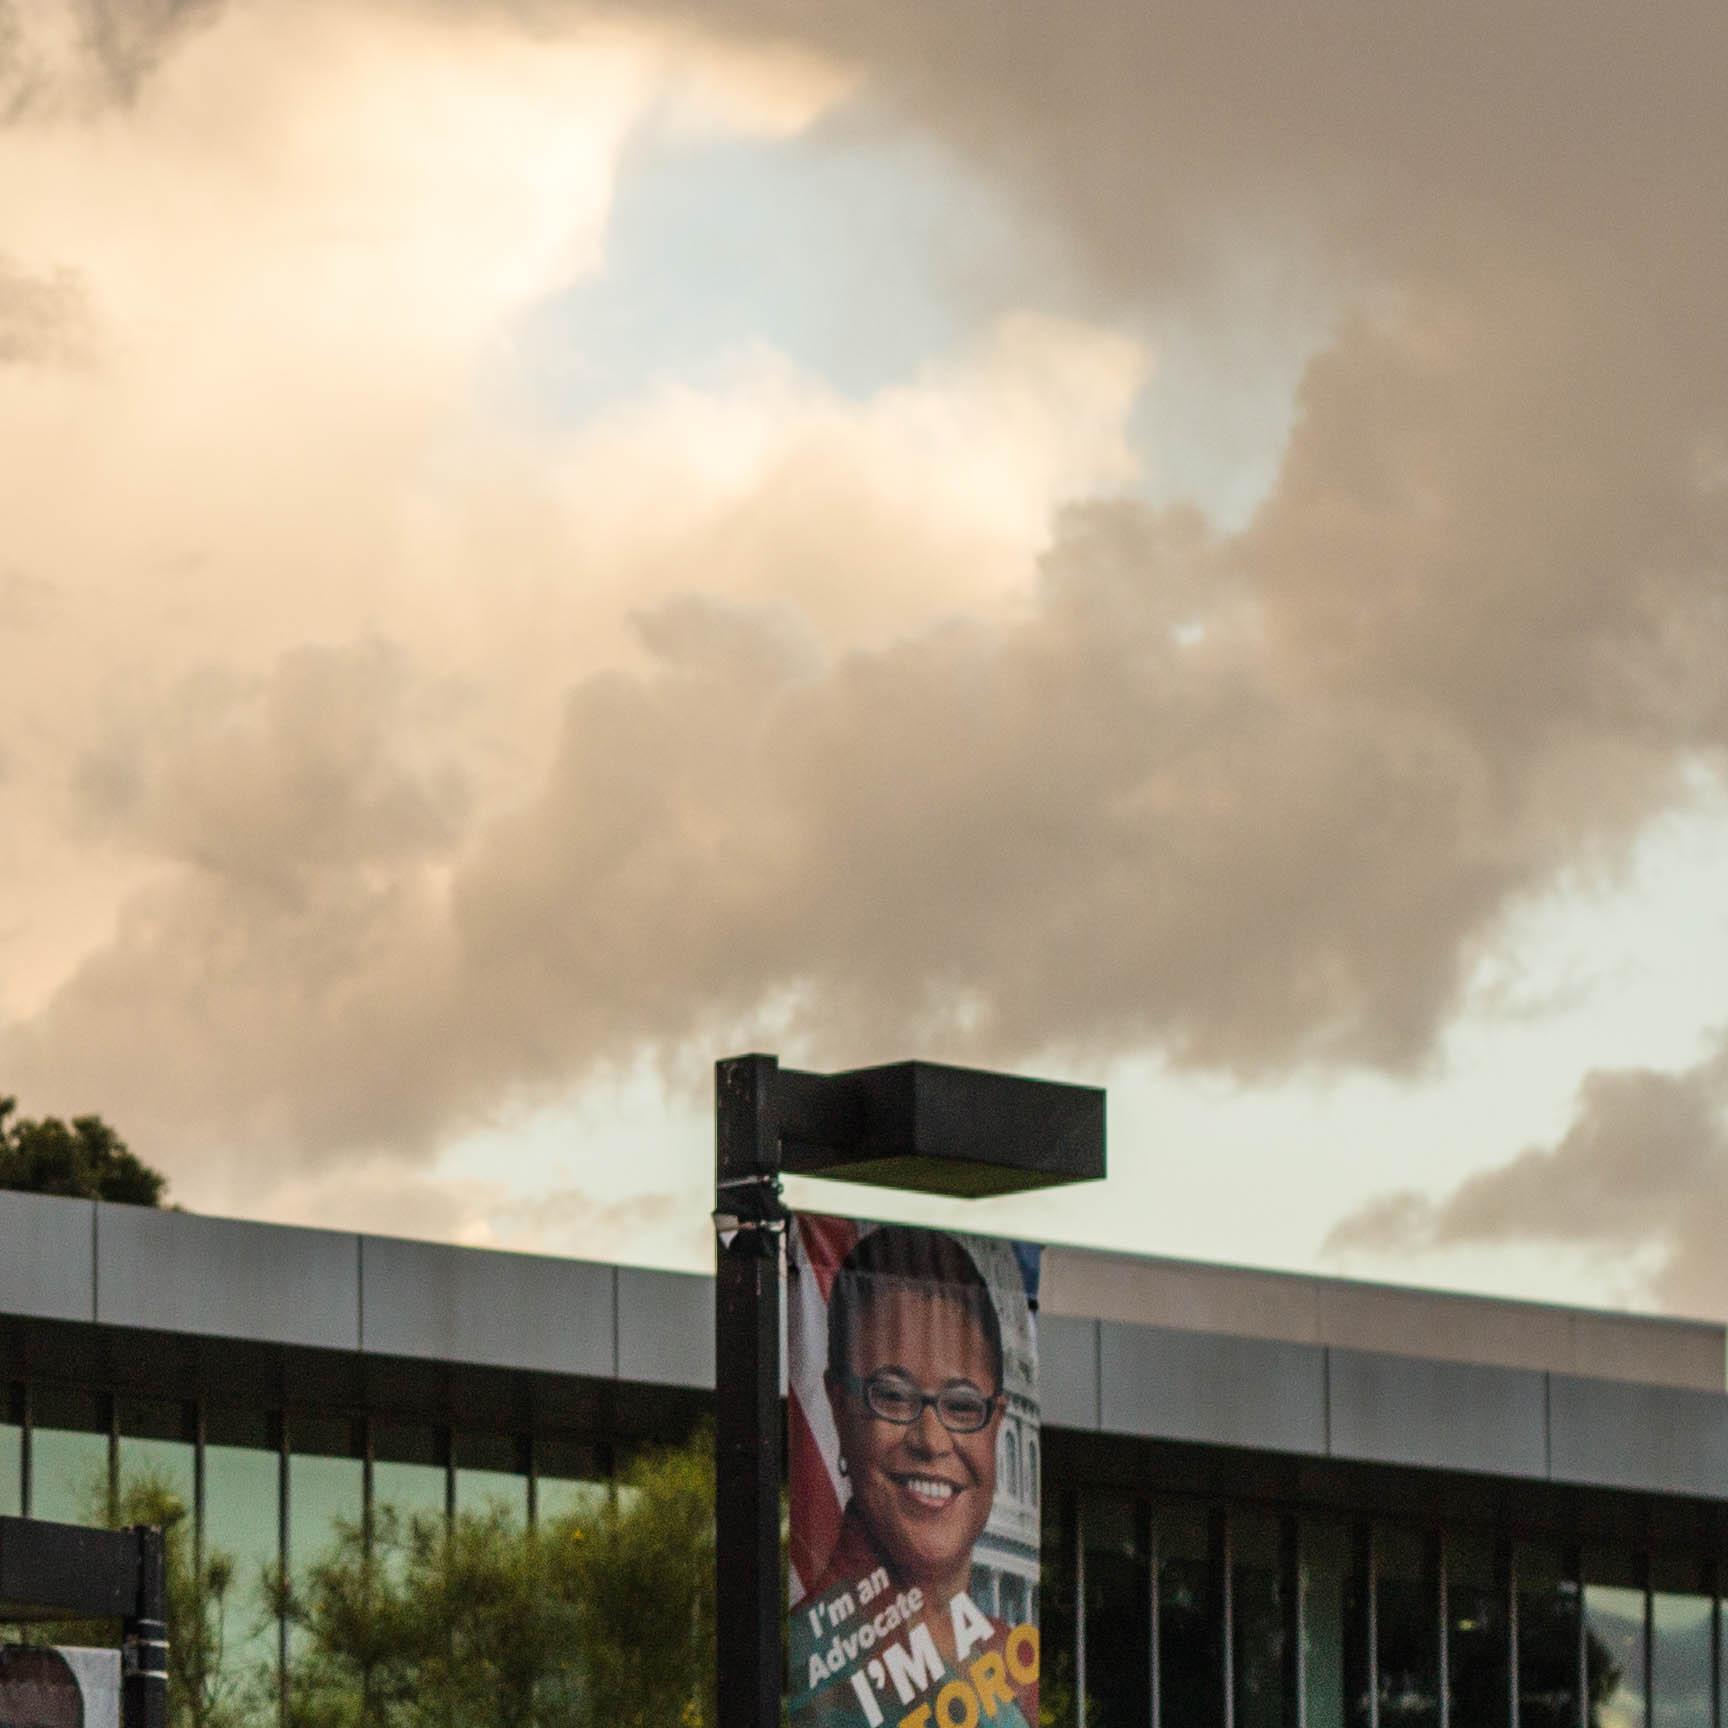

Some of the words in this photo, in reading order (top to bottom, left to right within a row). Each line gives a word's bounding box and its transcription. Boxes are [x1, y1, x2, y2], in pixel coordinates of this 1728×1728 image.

[808, 1592, 855, 1639] I'm
[856, 1566, 890, 1605] an
[808, 1586, 924, 1689] Advocate
[949, 1591, 996, 1662] A
